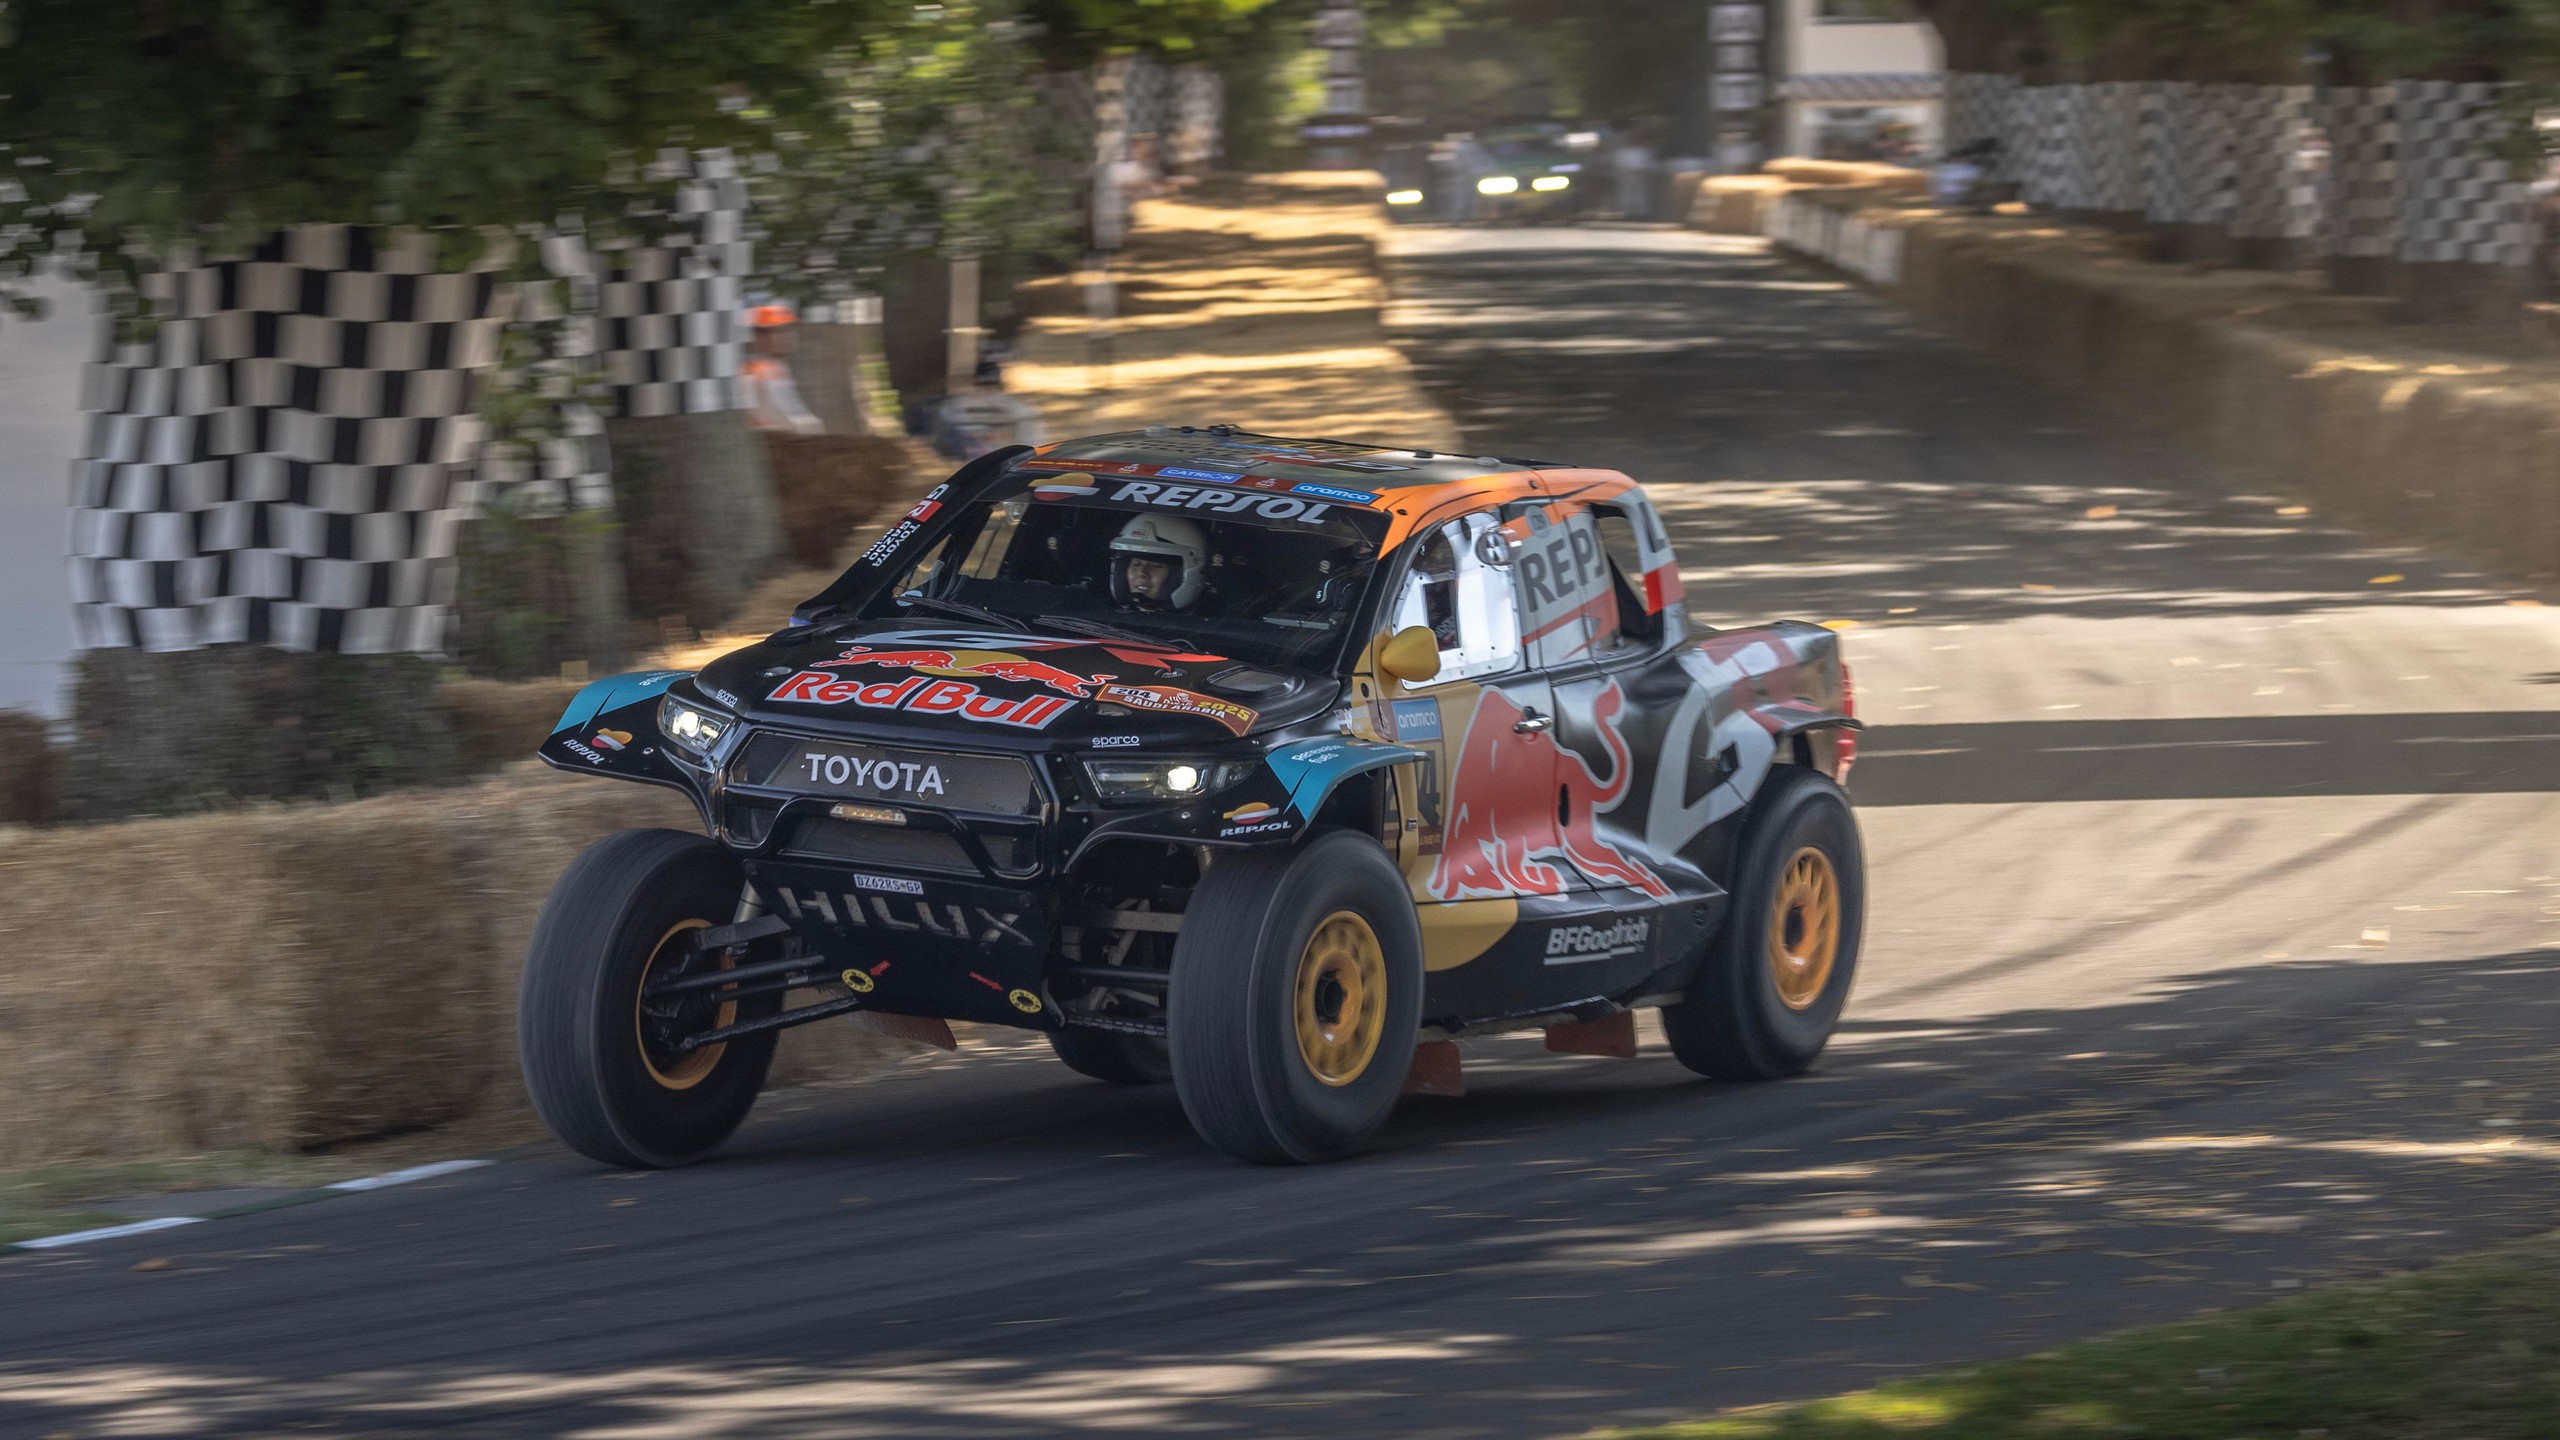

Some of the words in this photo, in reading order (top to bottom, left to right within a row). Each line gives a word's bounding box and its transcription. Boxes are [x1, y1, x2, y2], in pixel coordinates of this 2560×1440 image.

[1167, 468, 1236, 481] CATRION
[907, 483, 950, 518] GR
[1110, 482, 1331, 525] REPSOL
[1299, 484, 1370, 501] aramco
[868, 520, 912, 561] GAZOO
[871, 523, 921, 568] TOYOTA
[717, 688, 738, 707] sparco
[765, 671, 932, 710] Red
[903, 680, 1079, 730] Bull
[1115, 688, 1151, 700] 204
[1198, 701, 1252, 722] 2025
[1123, 695, 1169, 709] SAUDI
[1171, 702, 1226, 719] ARABIA
[1397, 711, 1437, 728] aramco
[562, 738, 607, 765] REPSOL
[1092, 735, 1140, 747] sparco
[805, 753, 944, 795] TOYOTA
[1220, 820, 1292, 837] REPSOL
[778, 886, 1034, 946] HILUX
[1545, 915, 1649, 955] BFGoodrich
